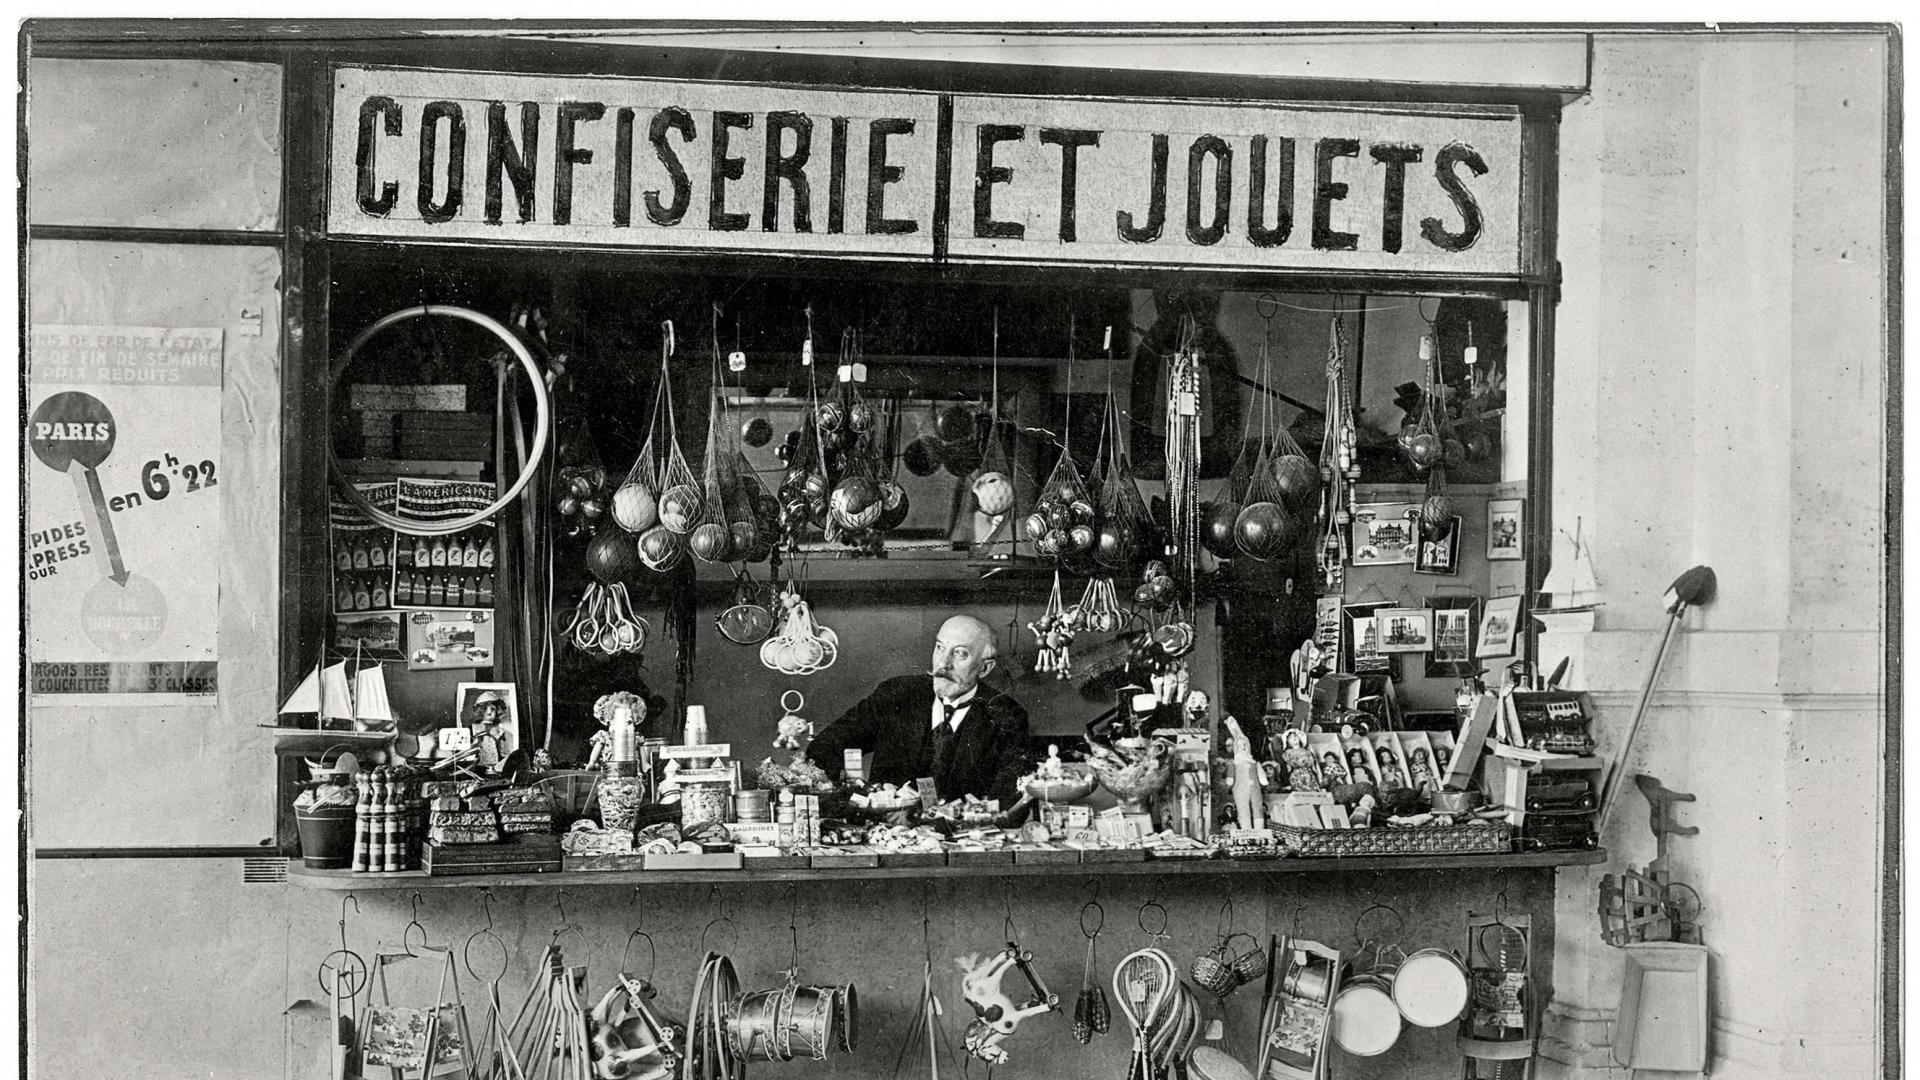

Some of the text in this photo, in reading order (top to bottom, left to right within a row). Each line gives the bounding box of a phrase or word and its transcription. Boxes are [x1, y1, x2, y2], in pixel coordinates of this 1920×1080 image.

[355, 95, 1489, 254] CONFISERIE ET JOUETS
[69, 335, 90, 347] DE
[132, 336, 153, 349] DE
[50, 350, 72, 365] DE
[80, 351, 107, 366] FIN
[117, 352, 138, 366] DE
[148, 352, 219, 367] SEMAINE
[42, 366, 180, 382] PRIX REDUITS
[35, 422, 109, 441] PARIS
[109, 492, 142, 512] en
[29, 521, 86, 549] PIDES
[29, 540, 91, 569] PRESS
[39, 678, 109, 691] COUCHETTES
[165, 677, 216, 692] CLASSES
